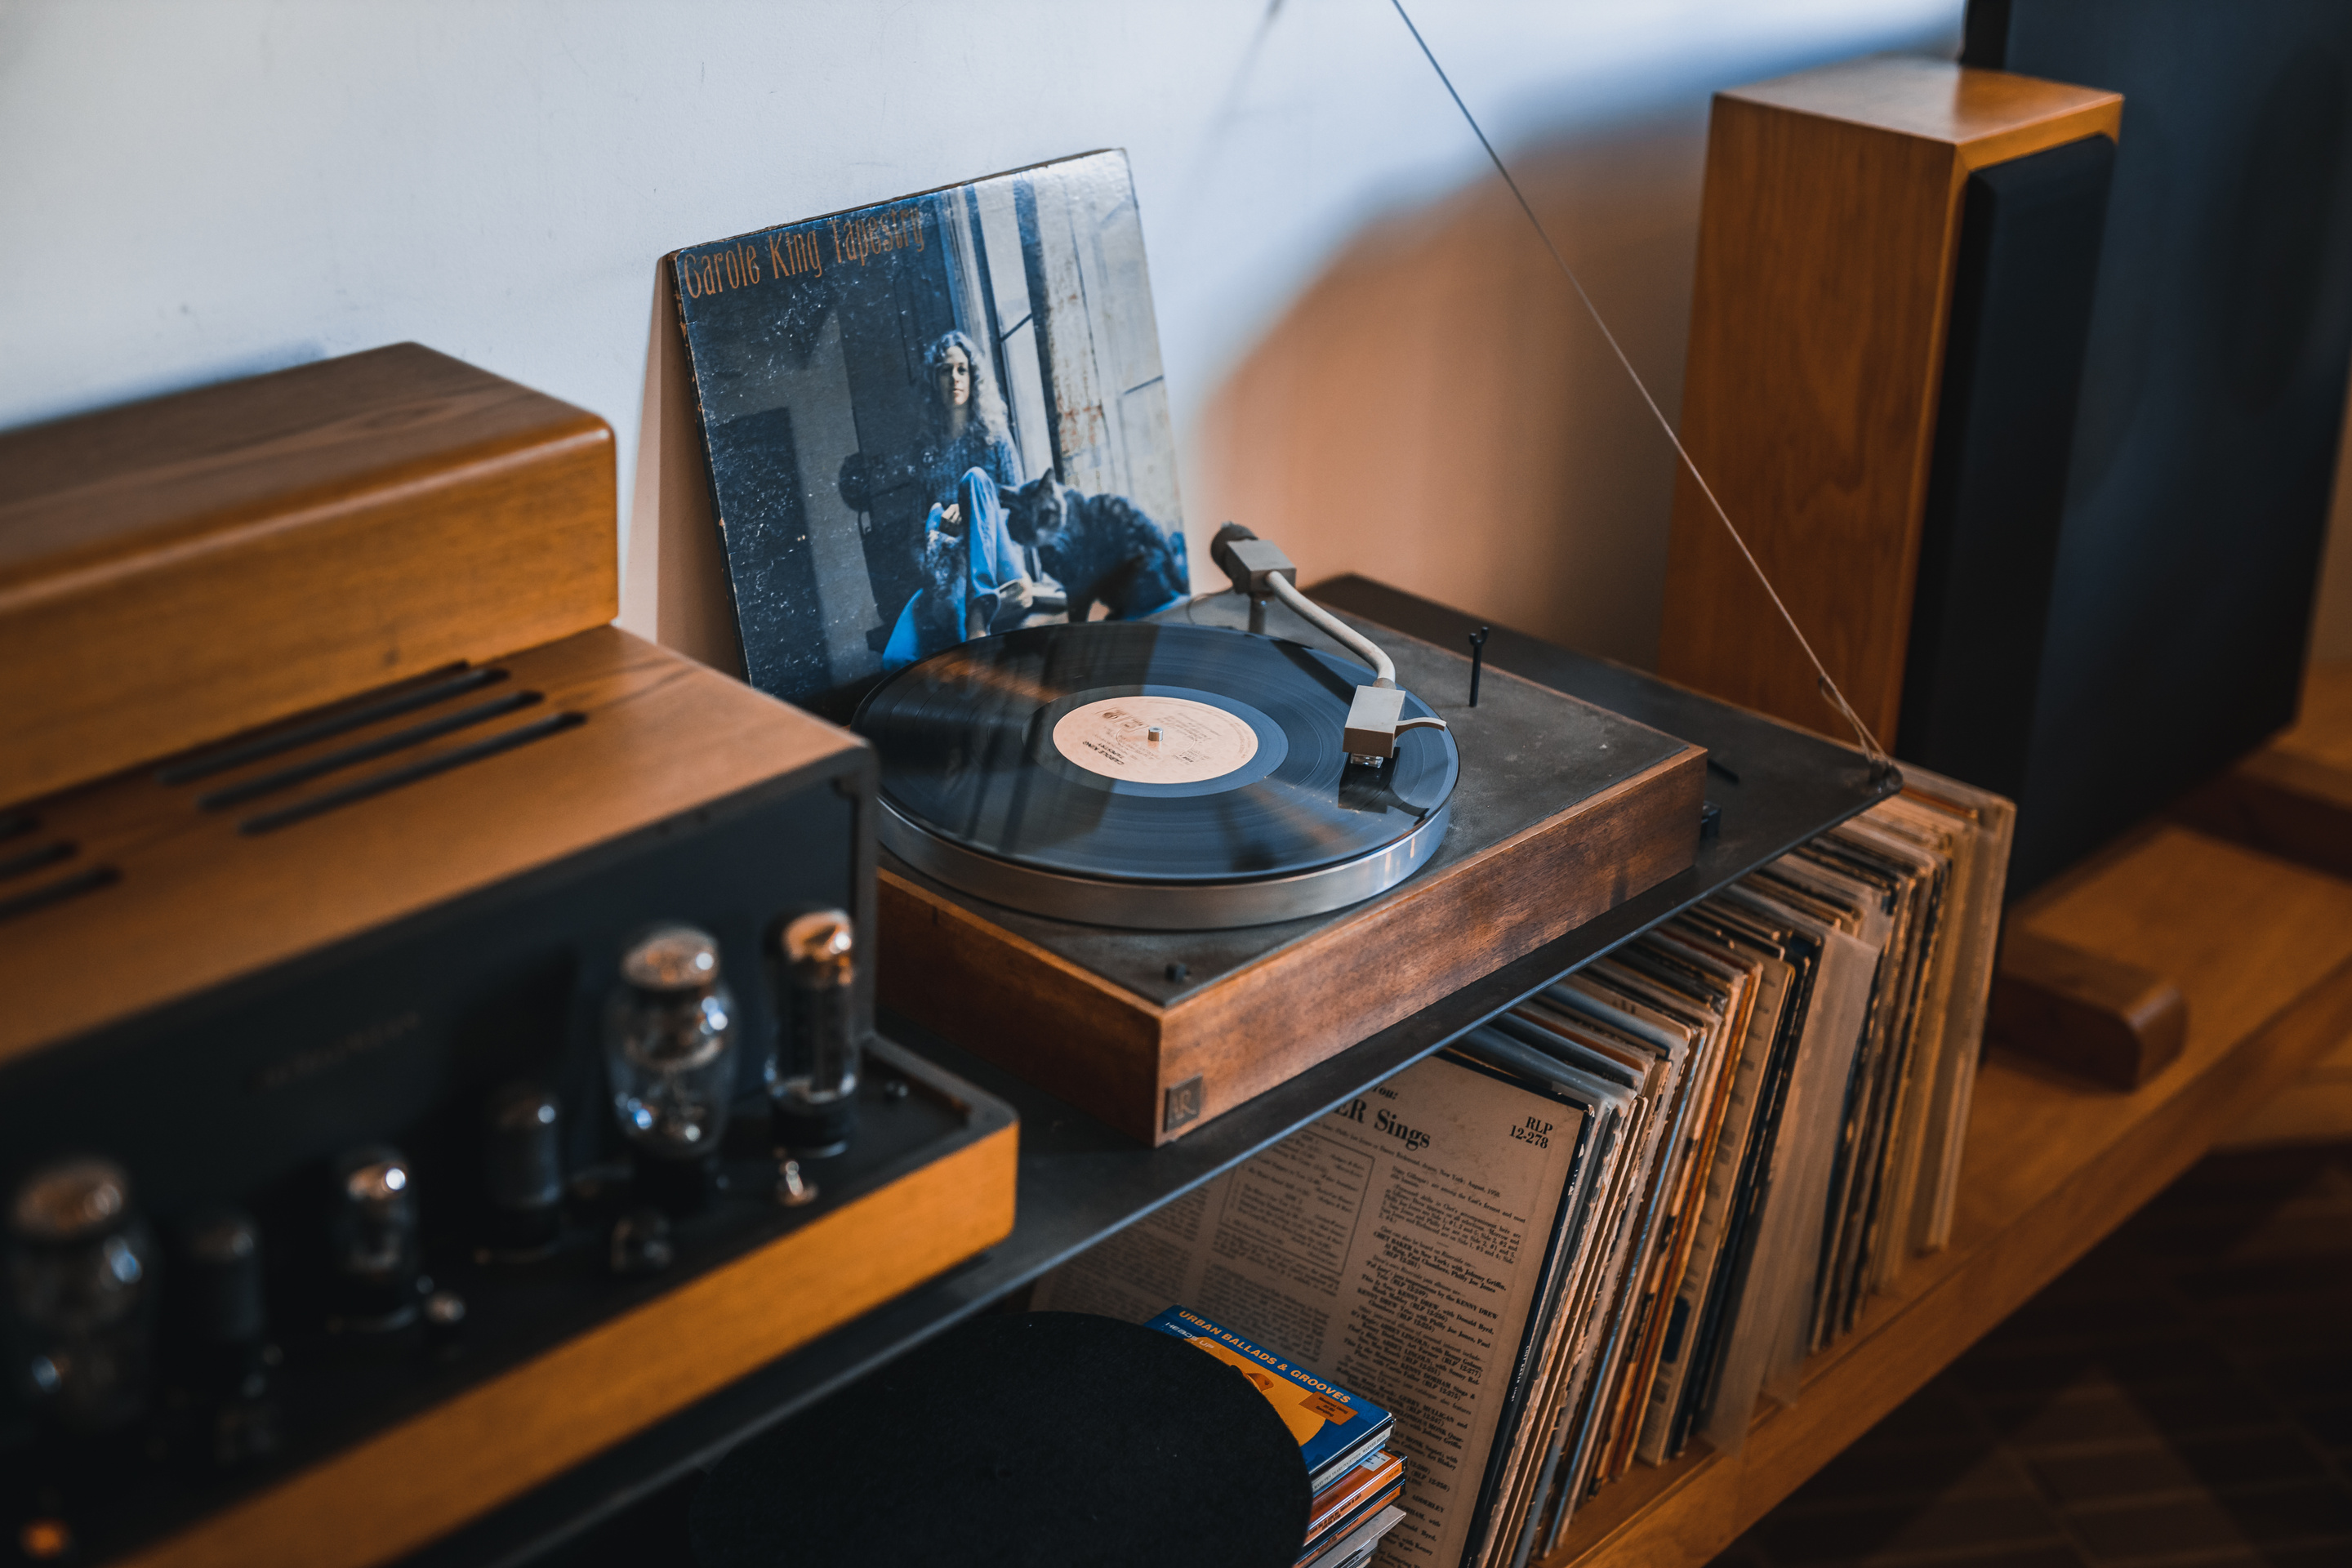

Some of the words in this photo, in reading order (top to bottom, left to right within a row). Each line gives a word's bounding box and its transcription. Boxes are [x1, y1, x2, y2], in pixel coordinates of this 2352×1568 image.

[684, 243, 760, 299] Carole
[768, 230, 822, 278] King
[826, 207, 924, 266] Tapestry
[1374, 1108, 1431, 1152] Sings
[1525, 1116, 1553, 1135] RLP
[1509, 1125, 1549, 1149] 12-278
[1450, 1264, 1463, 1272] with
[1463, 1268, 1485, 1282] Johnny
[1450, 1270, 1467, 1282] Philly
[1468, 1277, 1478, 1285] Joe
[1479, 1281, 1495, 1293] Jones
[1455, 1298, 1477, 1311] KENNY
[1478, 1307, 1498, 1319] DREW
[1455, 1313, 1477, 1326] Donald
[1446, 1325, 1457, 1334] Joe
[1477, 1338, 1490, 1348] Paul
[1179, 1310, 1222, 1335] URBAN
[1221, 1333, 1277, 1365] BALLADS
[1276, 1363, 1288, 1371] &
[1290, 1370, 1351, 1404] GROOVES
[1456, 1421, 1468, 1429] and
[1437, 1457, 1456, 1471] Blakey
